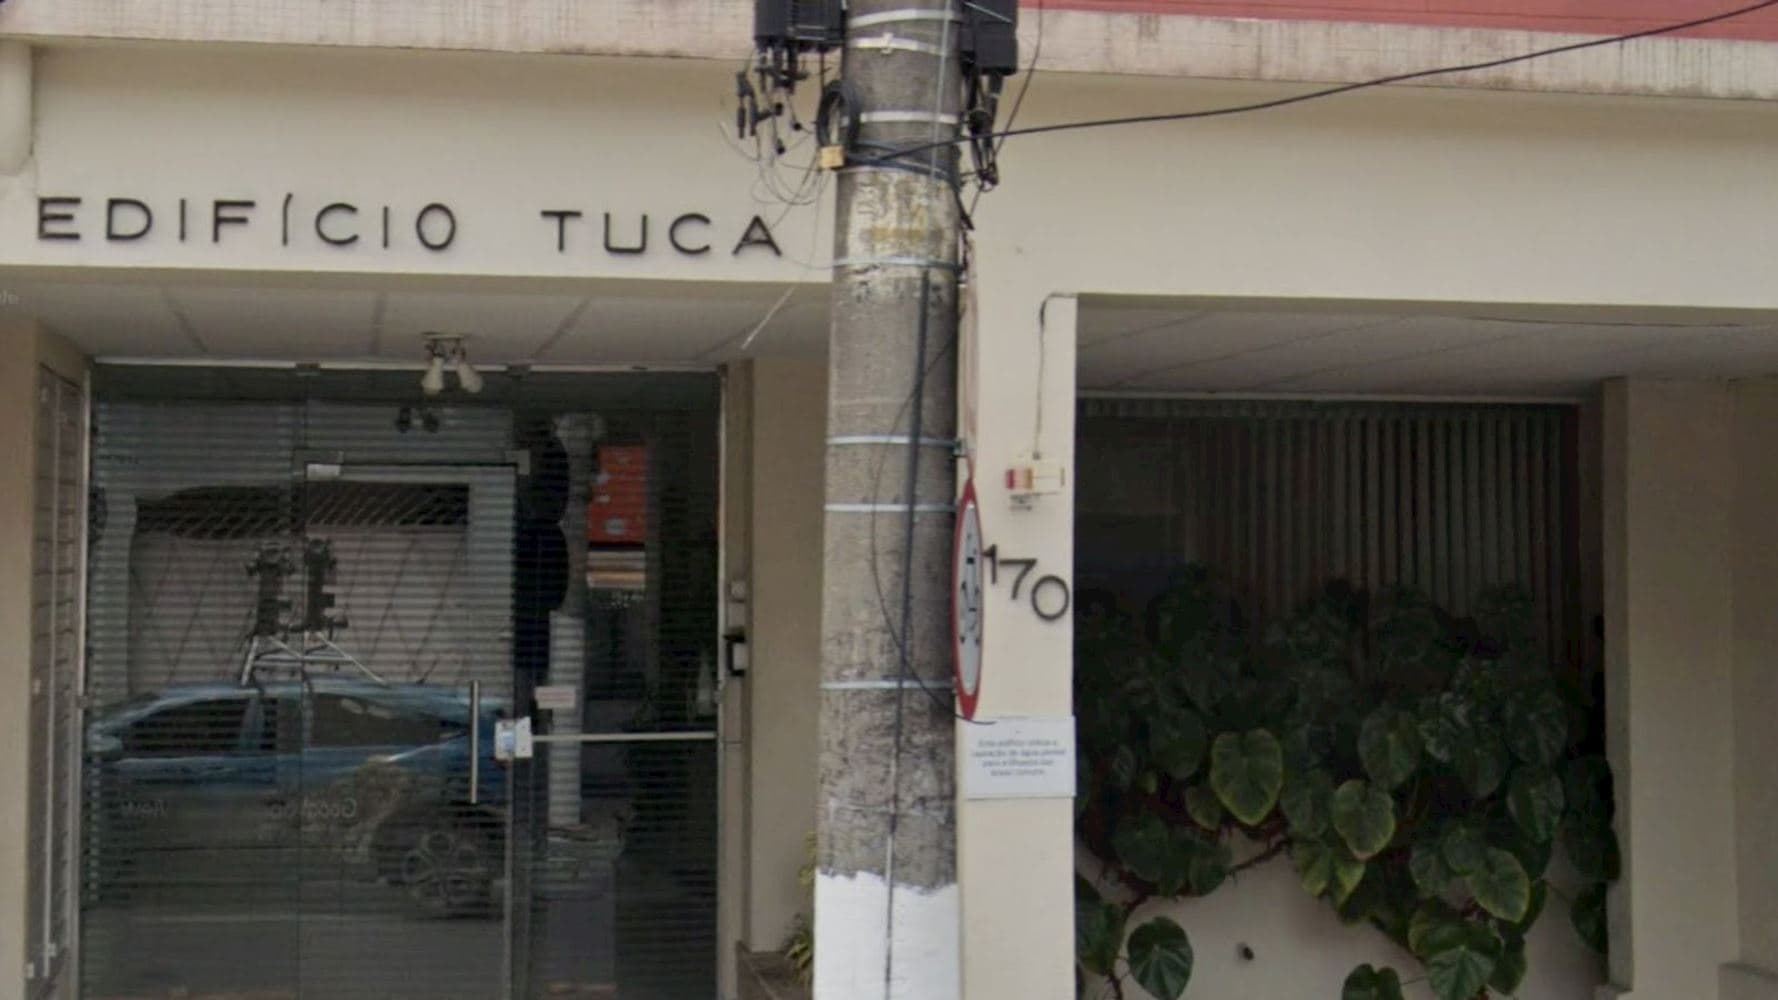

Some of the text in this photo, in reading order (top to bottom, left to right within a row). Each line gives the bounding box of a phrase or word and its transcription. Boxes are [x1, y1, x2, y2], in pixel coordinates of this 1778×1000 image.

[37, 193, 783, 256] EDIFÍCIO TUCA
[981, 543, 1070, 621] 170
